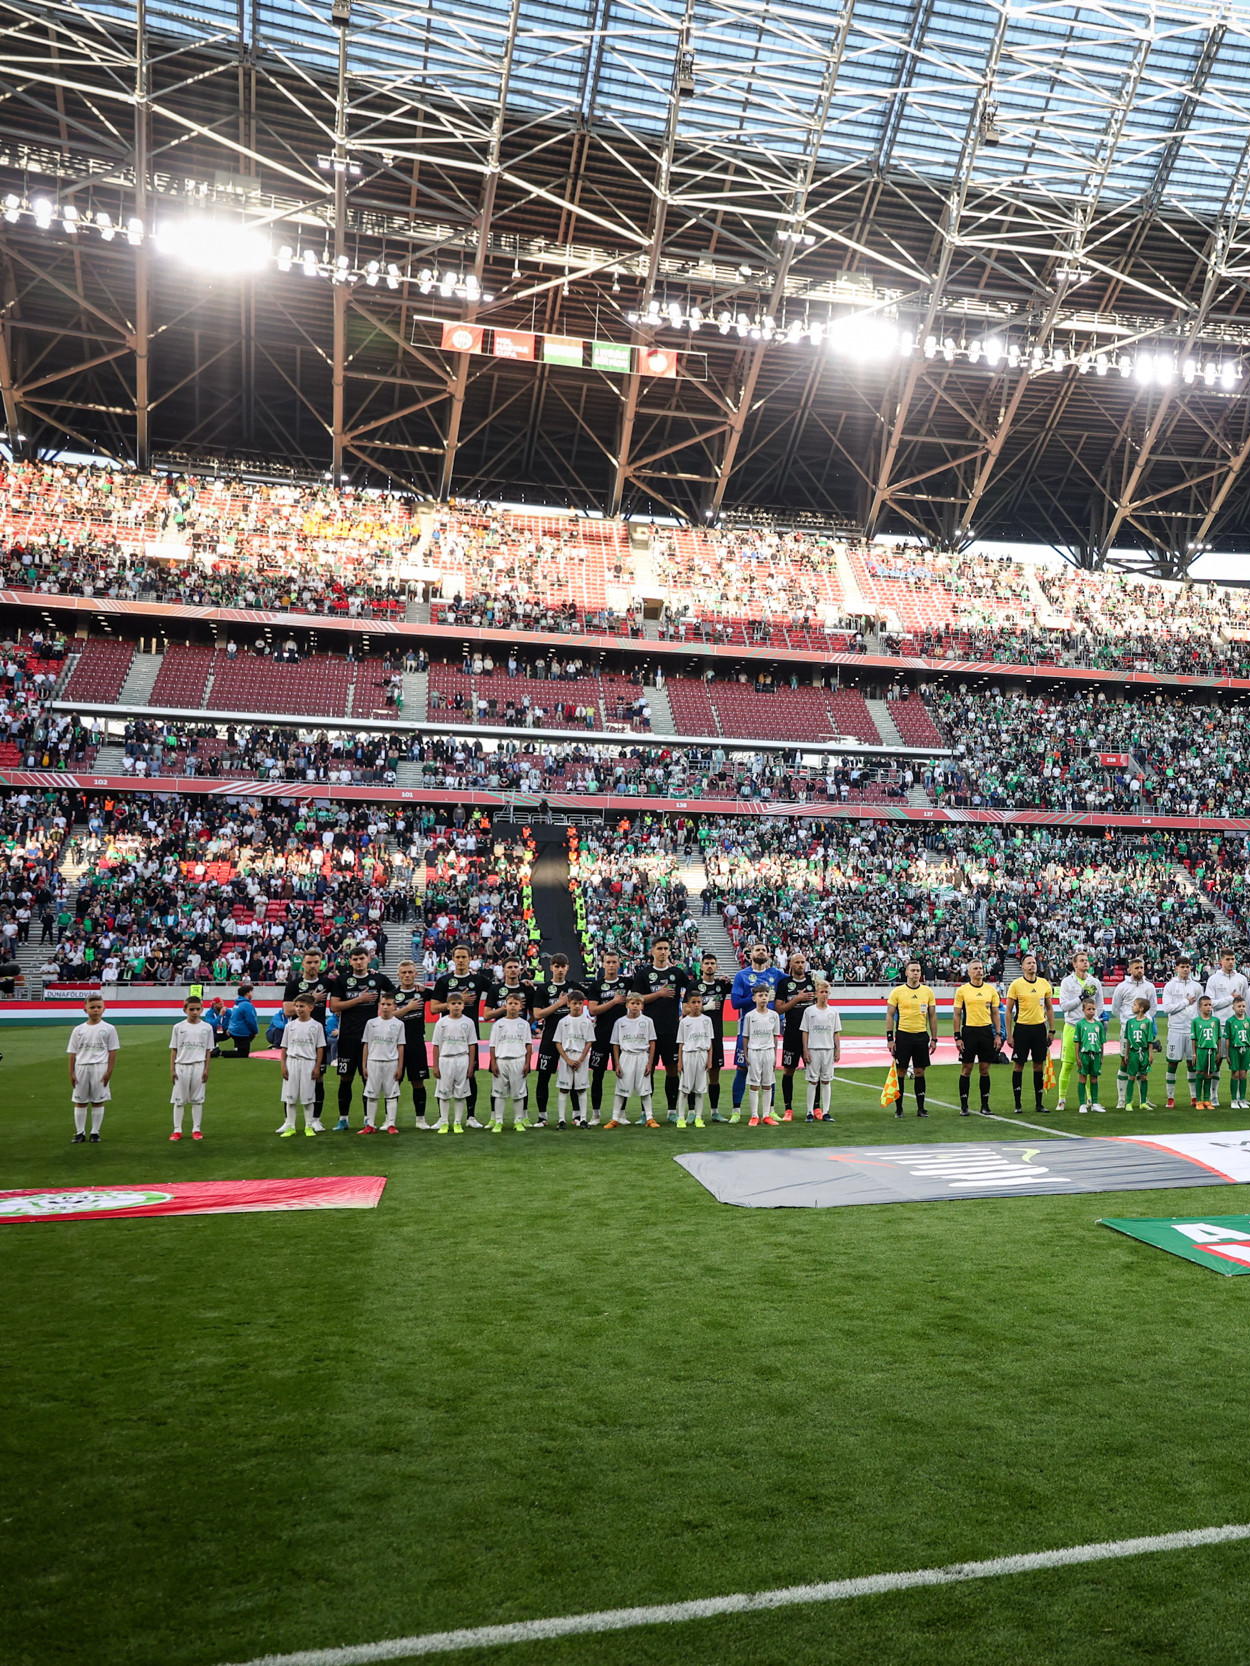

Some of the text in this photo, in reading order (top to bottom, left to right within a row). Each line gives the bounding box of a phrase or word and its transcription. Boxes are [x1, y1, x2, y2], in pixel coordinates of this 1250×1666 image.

[540, 1059, 548, 1070] 12
[783, 1055, 792, 1065] 30
[339, 1062, 347, 1073] 23
